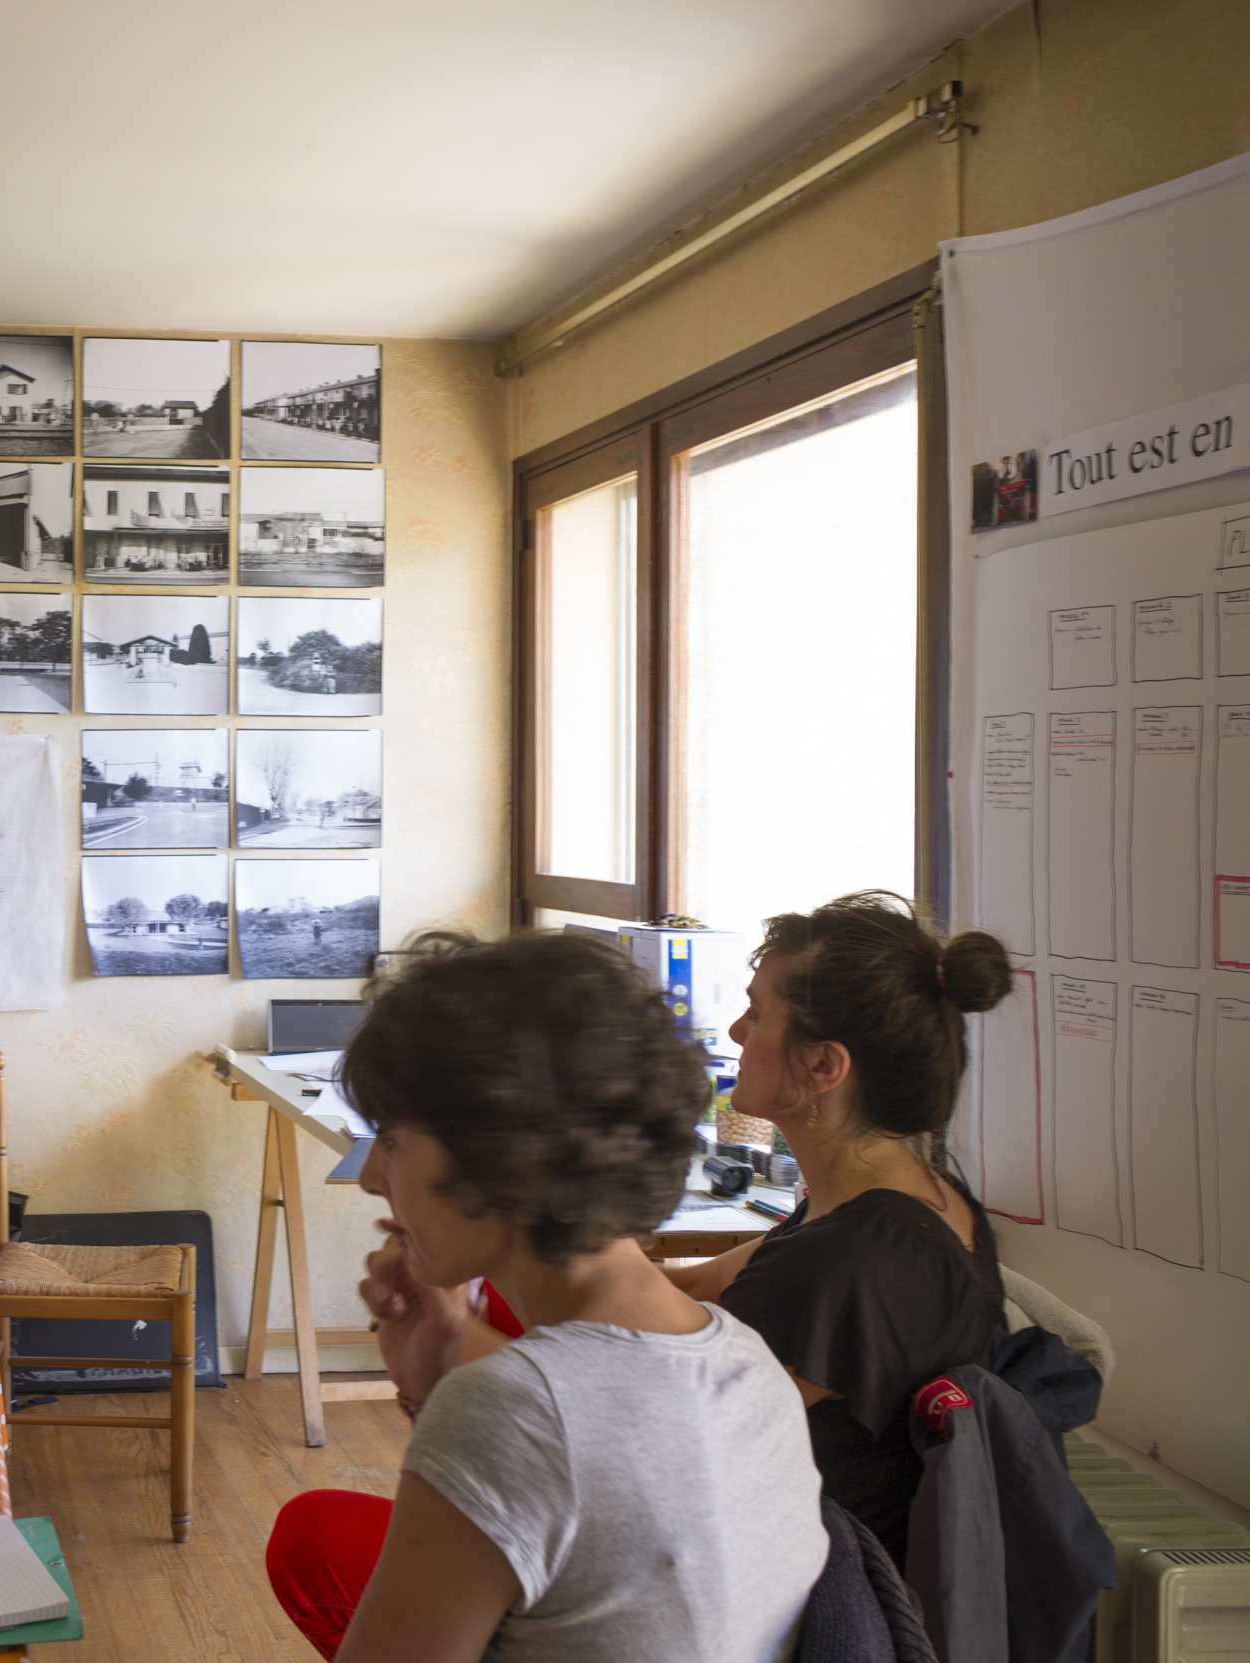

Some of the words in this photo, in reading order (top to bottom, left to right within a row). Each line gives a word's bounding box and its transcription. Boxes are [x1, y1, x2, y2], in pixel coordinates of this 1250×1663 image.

[1048, 440, 1118, 496] Tout
[1127, 423, 1180, 474] est
[1190, 415, 1234, 458] en
